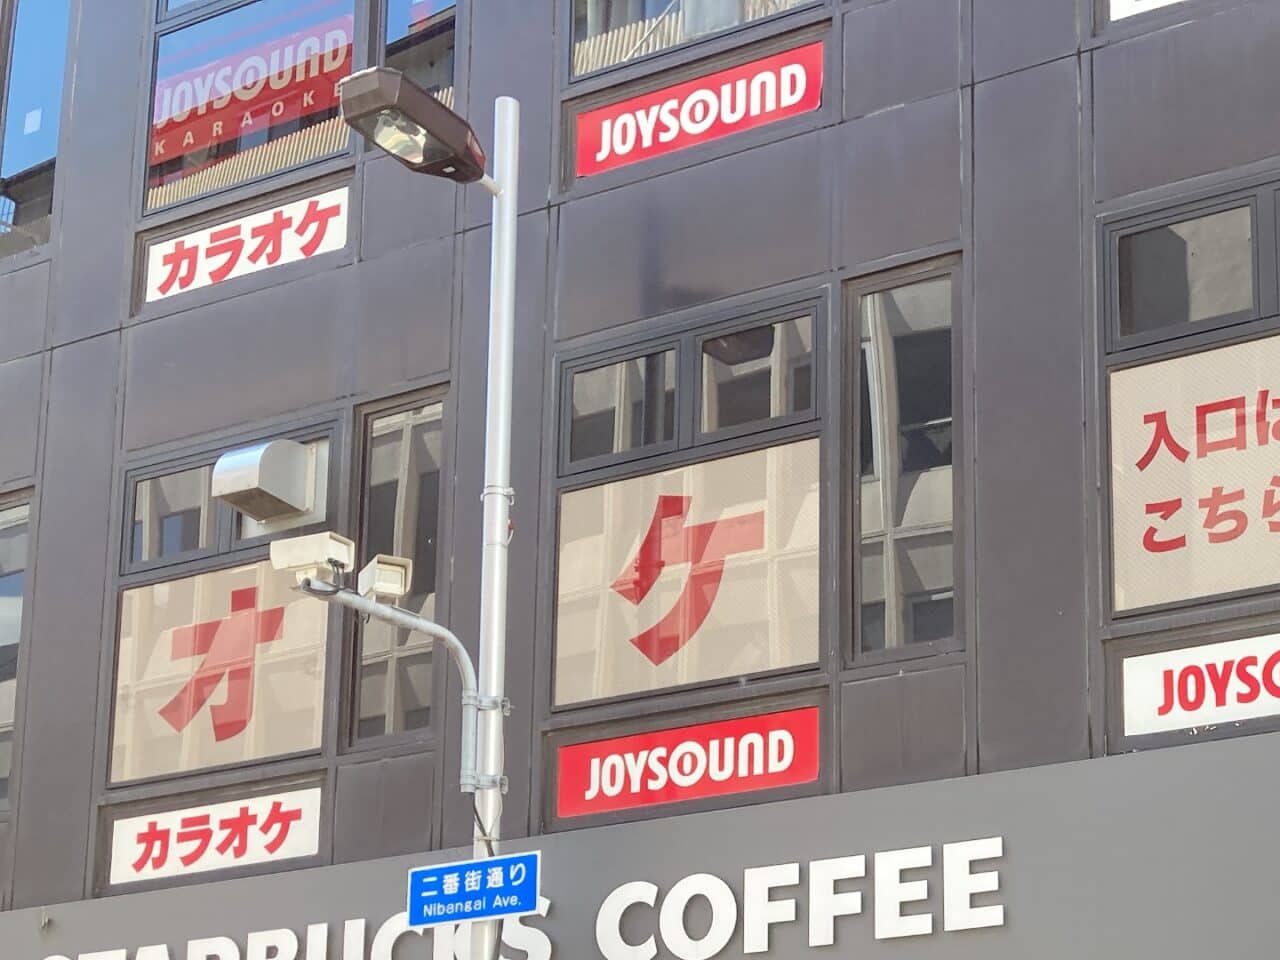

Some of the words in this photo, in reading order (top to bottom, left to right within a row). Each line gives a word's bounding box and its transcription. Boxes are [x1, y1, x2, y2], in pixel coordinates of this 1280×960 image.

[155, 28, 348, 129] JOYSOUND
[595, 62, 807, 163] JOYSOUND
[154, 83, 342, 156] KARAOKE
[157, 199, 342, 297] カラオケ
[584, 728, 795, 801] JOYSOUND
[132, 801, 303, 873] カラオケ
[421, 863, 527, 897] 二番街通り
[423, 897, 486, 918] Nibangai
[493, 894, 522, 908] Ave.
